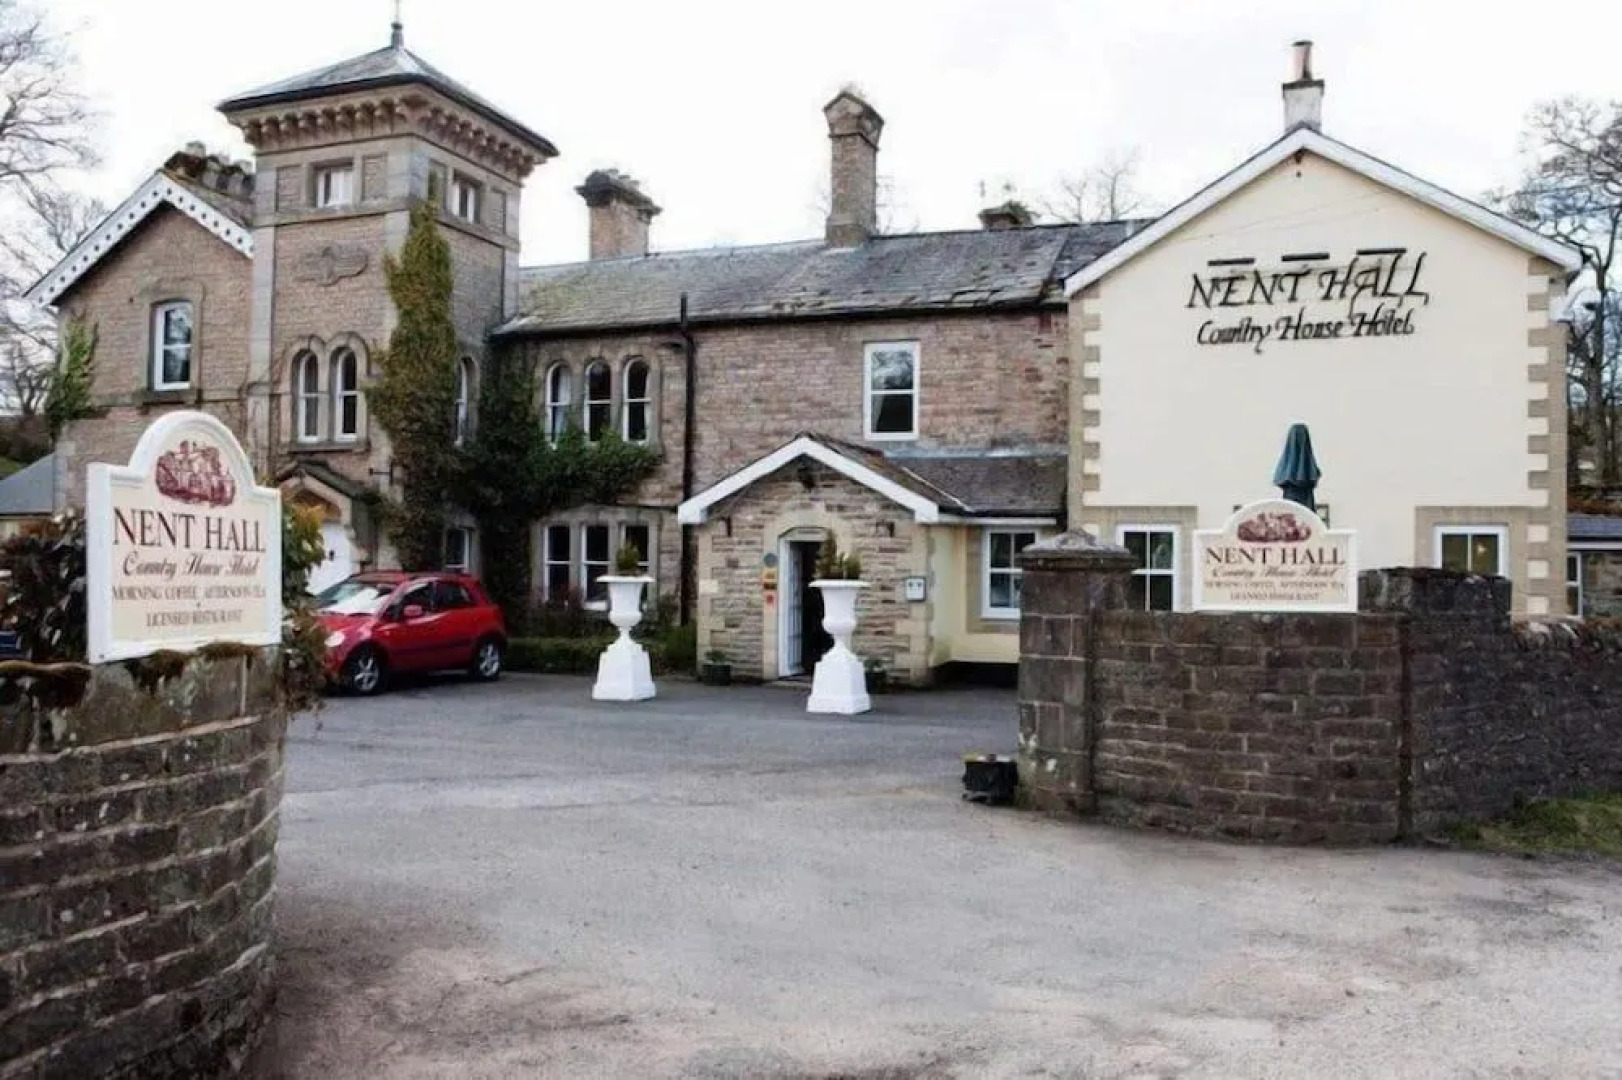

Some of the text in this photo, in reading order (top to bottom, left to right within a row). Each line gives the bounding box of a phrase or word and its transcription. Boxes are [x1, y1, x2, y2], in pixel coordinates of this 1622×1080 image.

[1186, 250, 1429, 318] NENT HALL
[1197, 302, 1415, 355] Country House Hotel
[113, 507, 267, 553] NENT HALL
[123, 551, 176, 582] Country
[1206, 547, 1346, 564] NENT HALL
